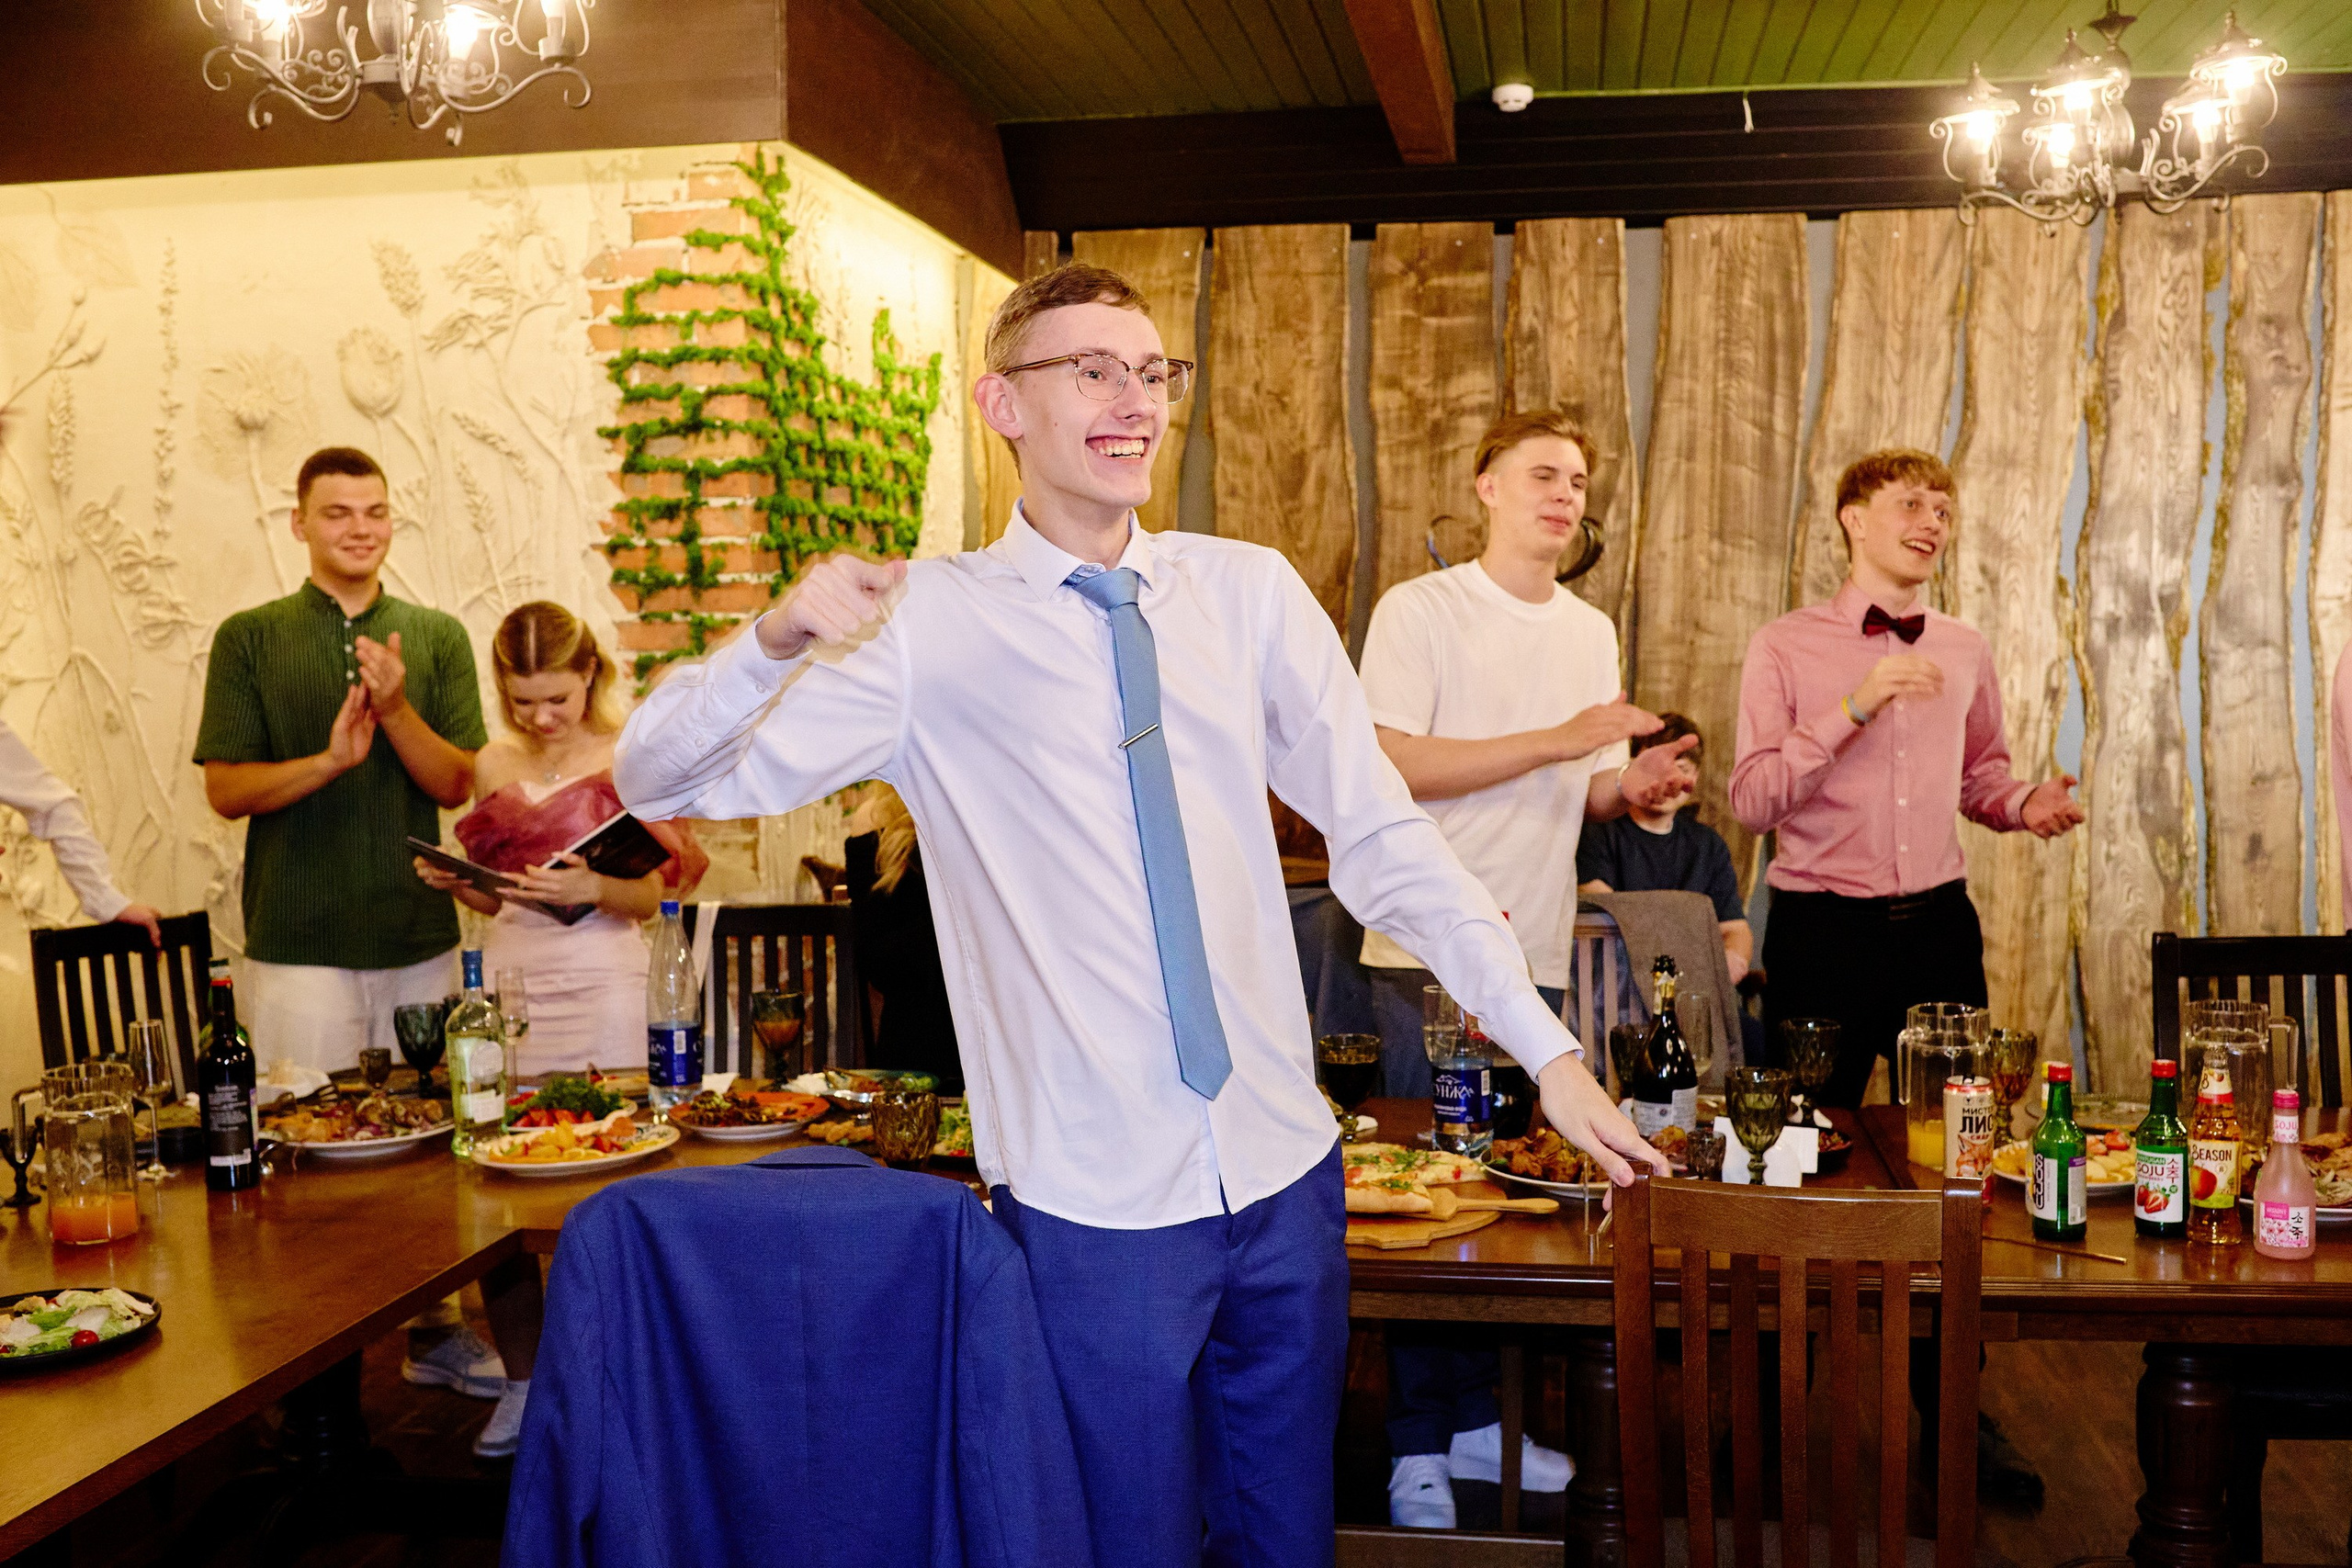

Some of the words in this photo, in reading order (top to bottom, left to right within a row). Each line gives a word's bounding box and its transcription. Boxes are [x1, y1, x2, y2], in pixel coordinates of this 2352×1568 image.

[1959, 1114, 1994, 1134] ЛИС
[2275, 1120, 2297, 1131] SOJU
[2137, 1161, 2165, 1177] SOJU
[2166, 1157, 2179, 1184] 소주
[2290, 1211, 2304, 1240] 소주
